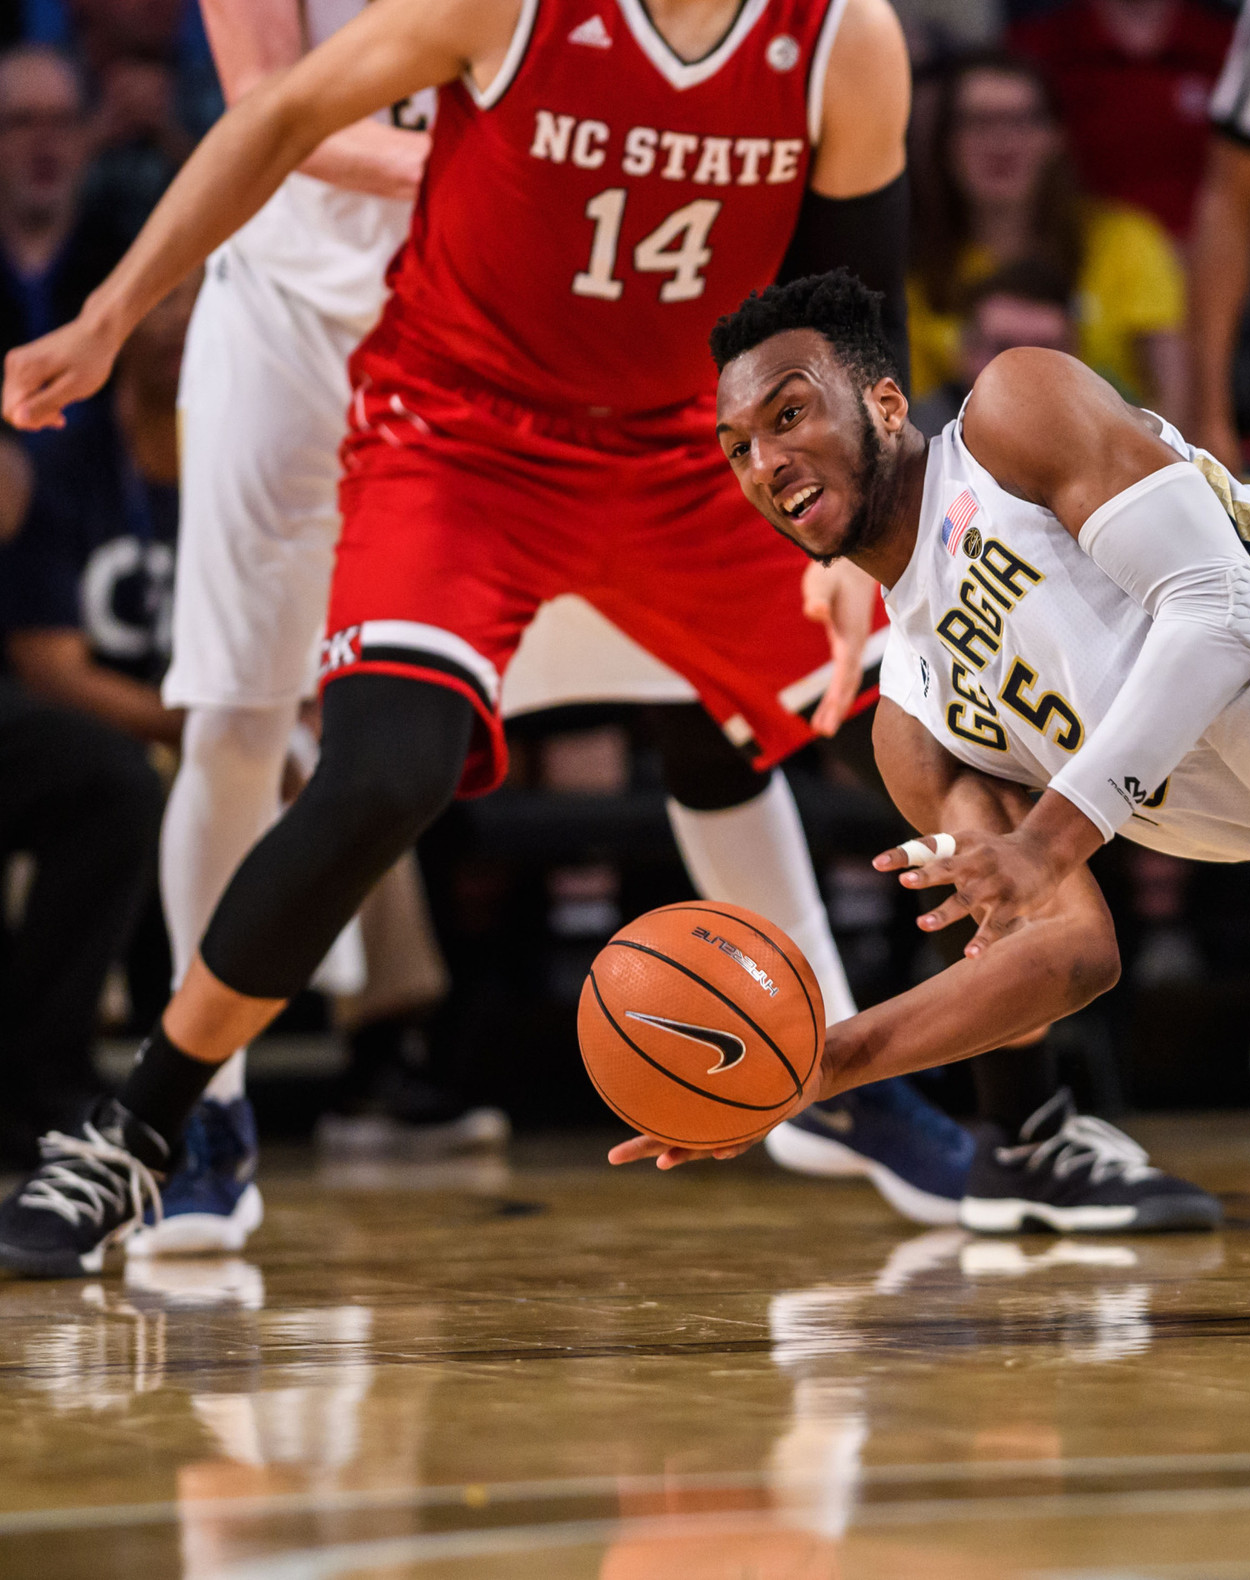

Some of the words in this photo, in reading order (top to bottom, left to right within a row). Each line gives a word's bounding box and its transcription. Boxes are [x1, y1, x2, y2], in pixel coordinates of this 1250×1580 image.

[529, 109, 610, 170] NC
[621, 126, 804, 187] STATE
[571, 187, 723, 302] 14
[935, 537, 1046, 752] GERGIA
[998, 654, 1085, 754] 5
